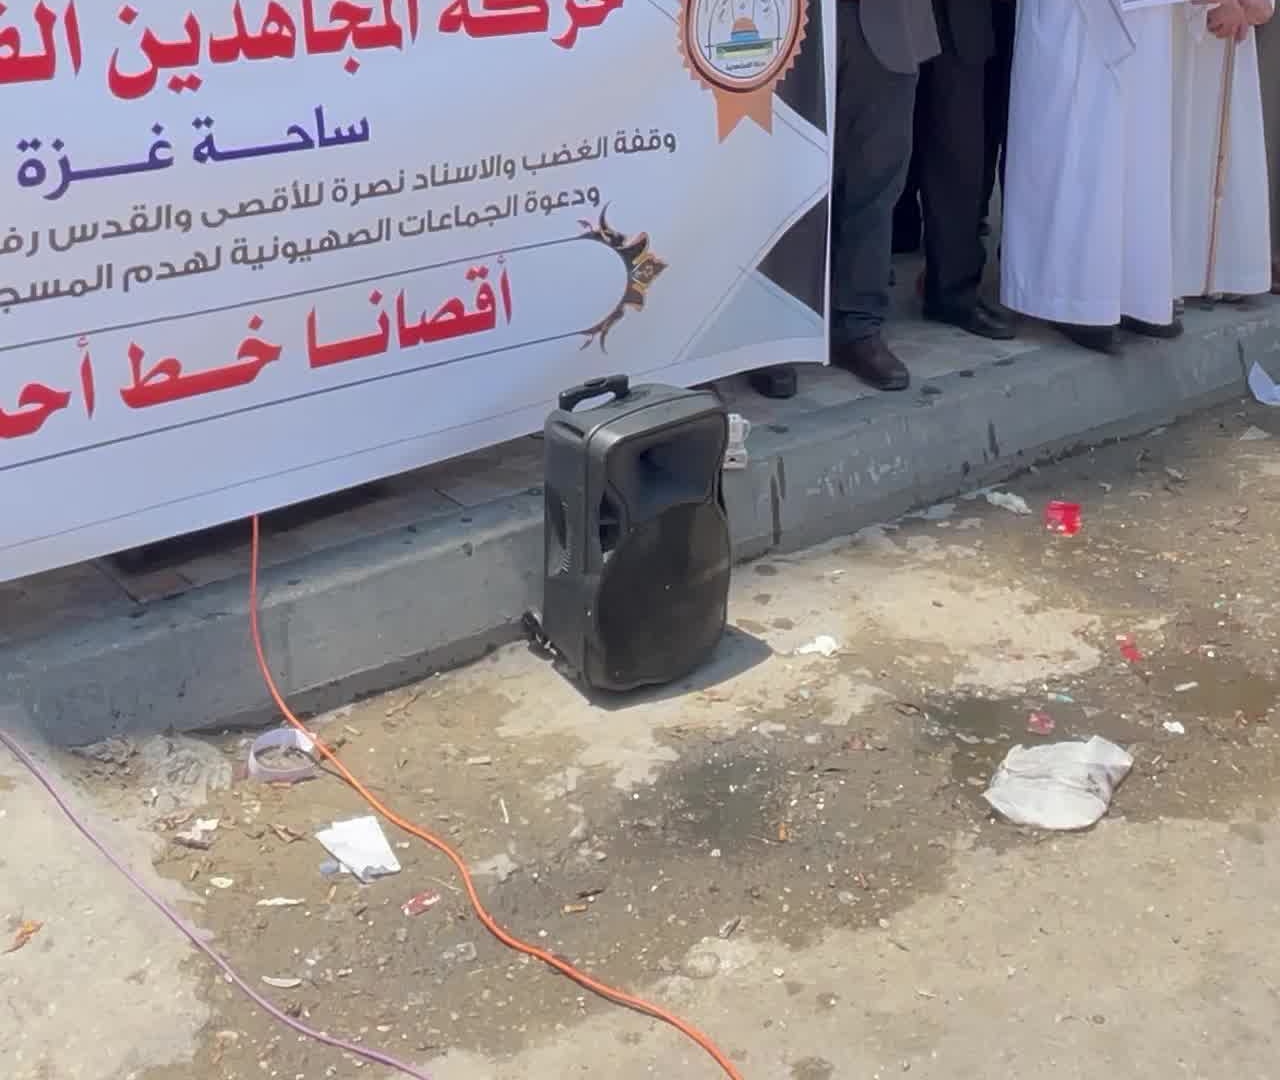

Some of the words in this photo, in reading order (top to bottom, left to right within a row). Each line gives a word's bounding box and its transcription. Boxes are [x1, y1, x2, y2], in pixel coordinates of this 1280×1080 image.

[192, 104, 369, 164] ساحة
[522, 136, 608, 170] الغضب
[614, 127, 676, 154] وقفة
[17, 123, 174, 200] غزة
[413, 150, 515, 191] والاسناد
[201, 181, 324, 228] للأقصى
[332, 168, 404, 206] نصرة
[525, 187, 600, 216] ودعوة
[49, 204, 192, 252] والقدس
[399, 194, 518, 237] الجماعات
[230, 218, 391, 265] الصهيونية
[123, 246, 221, 292] لهدم
[308, 257, 512, 368] أقصانا
[120, 316, 282, 409] خط
